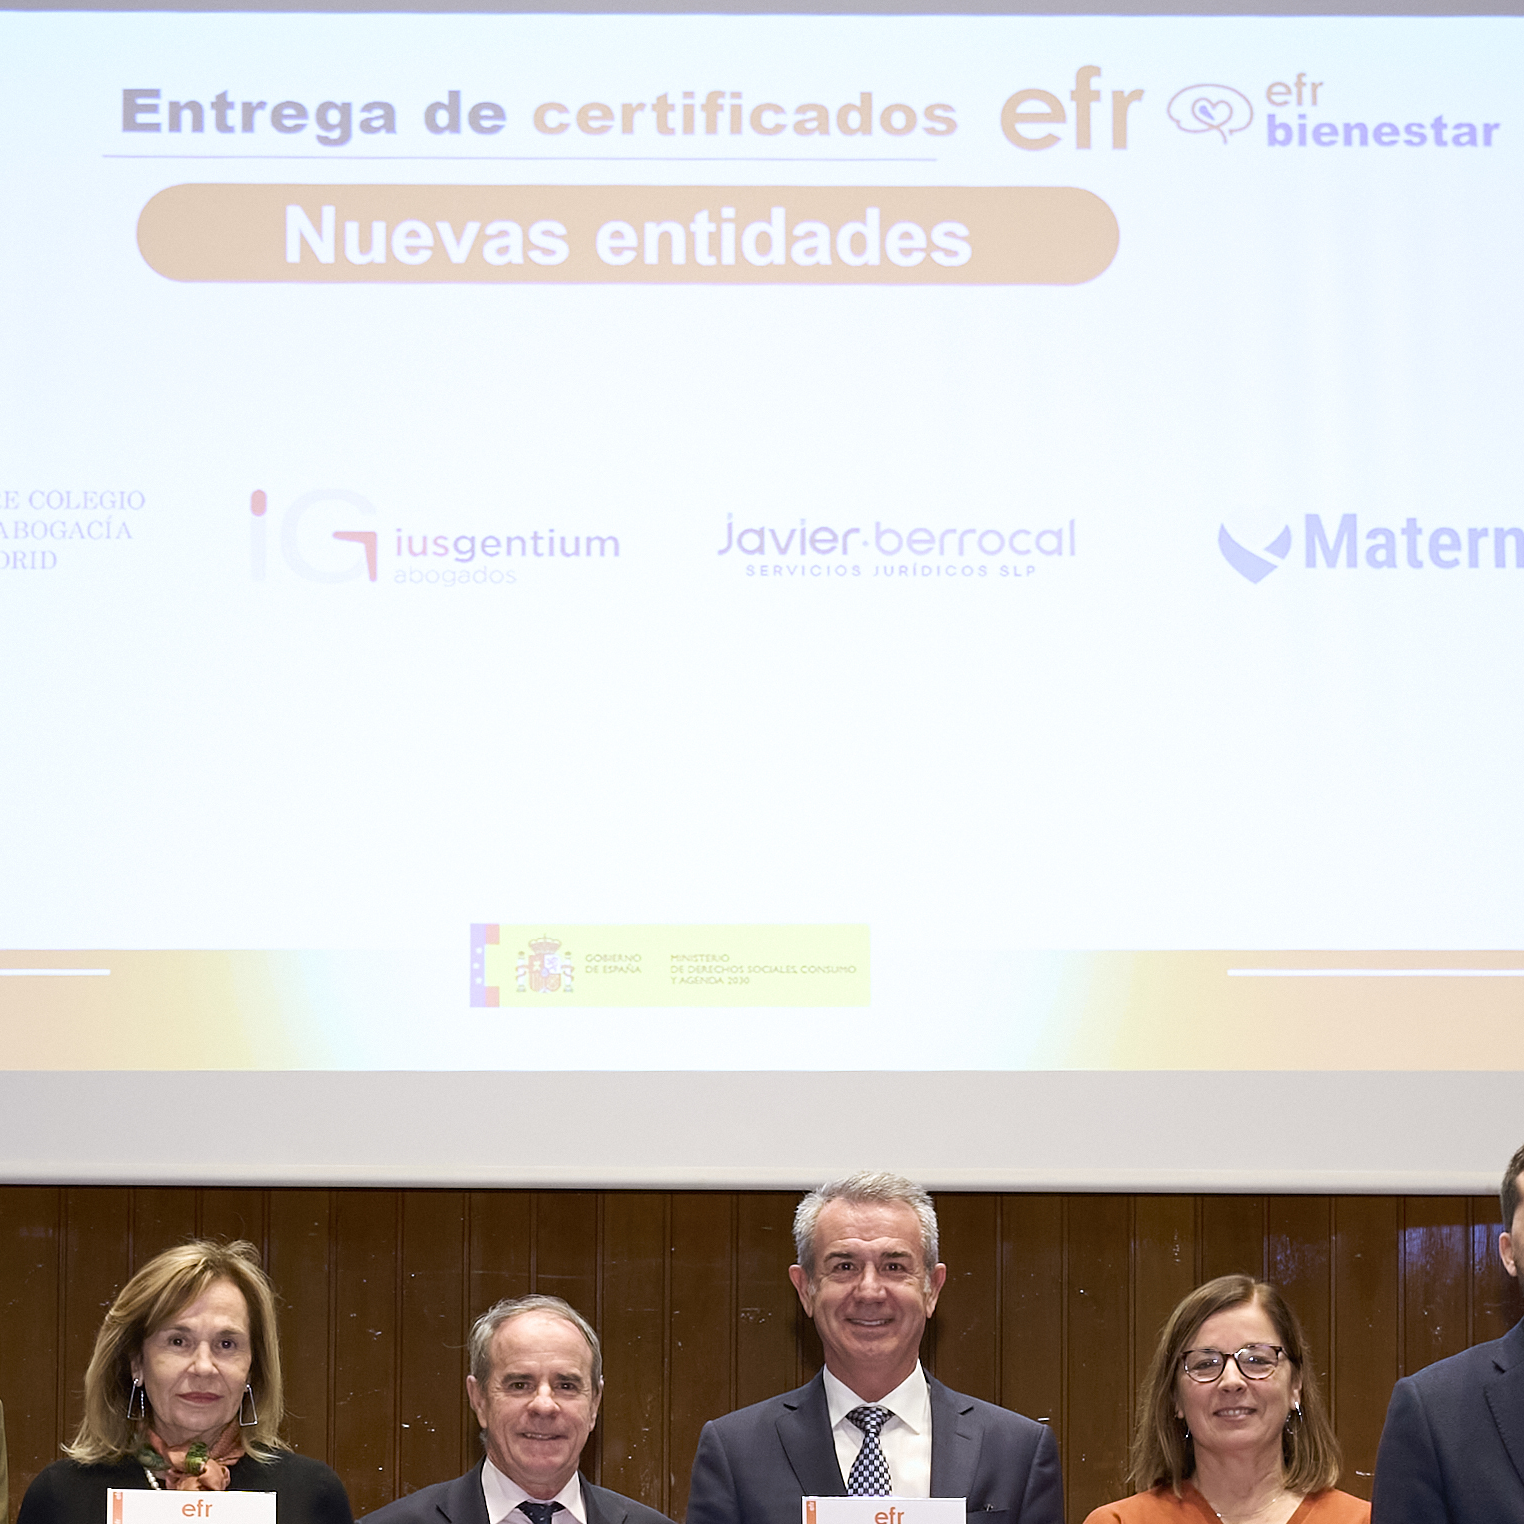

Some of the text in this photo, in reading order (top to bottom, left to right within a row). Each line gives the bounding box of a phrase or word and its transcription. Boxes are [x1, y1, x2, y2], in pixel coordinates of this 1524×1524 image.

[1266, 72, 1324, 107] efr
[122, 88, 958, 147] Entrega de certificados
[1000, 65, 1145, 151] efr
[1267, 114, 1501, 147] bienestar
[282, 205, 971, 269] Nuevas entidades
[28, 489, 146, 510] COLEGIO
[396, 528, 620, 563] iusgentium
[393, 565, 517, 587] abogados
[746, 562, 1036, 577] SERVICIOS JURÍDICOS SLP
[585, 954, 642, 963] GOBIERNO
[670, 954, 729, 963] MINISTERIO
[670, 966, 684, 974] DE
[688, 966, 744, 974] DERECHOS
[801, 966, 856, 974] CONSUMO
[182, 1499, 213, 1517] efr
